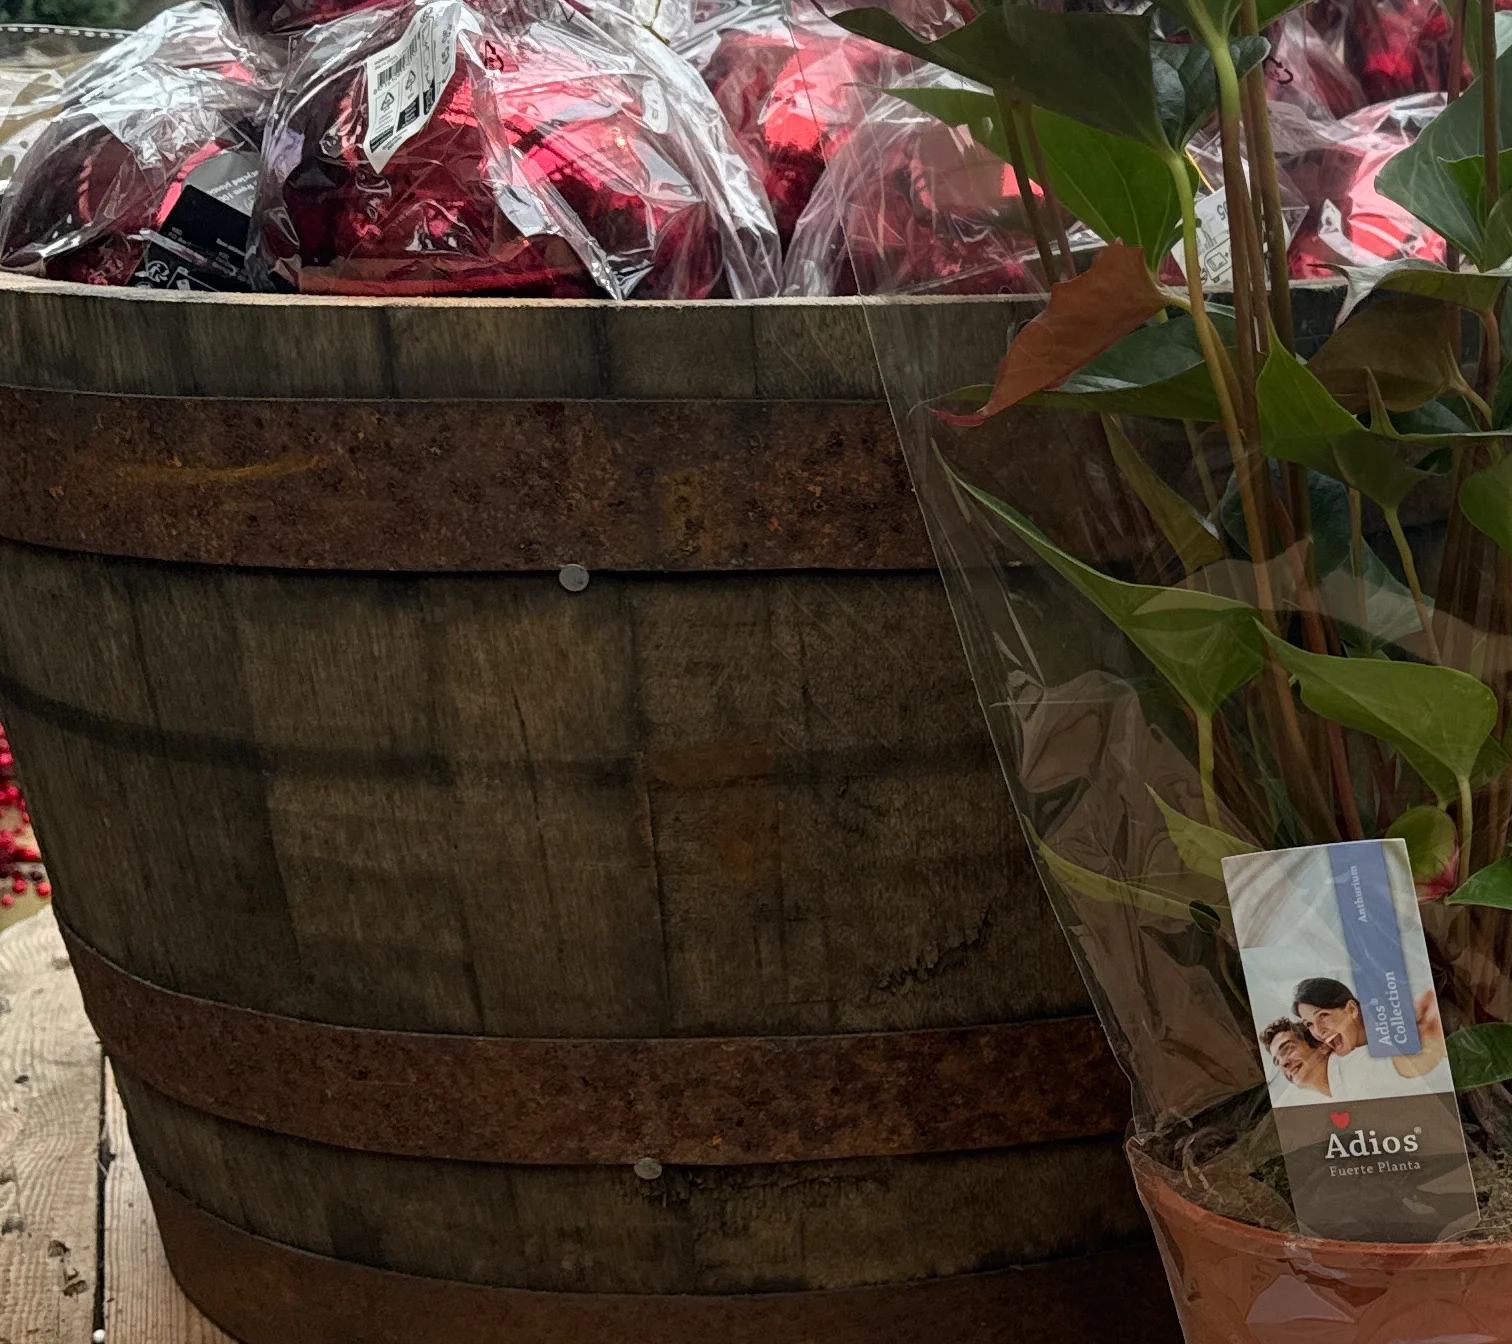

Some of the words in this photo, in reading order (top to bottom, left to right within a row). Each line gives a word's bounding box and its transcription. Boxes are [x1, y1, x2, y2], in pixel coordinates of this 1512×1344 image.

[1350, 865, 1367, 923] Anthurium
[1385, 971, 1408, 1045] Collection
[1324, 1129, 1419, 1160] Adios
[1329, 1165, 1374, 1177] Fuerte
[1377, 1160, 1421, 1173] Planta
